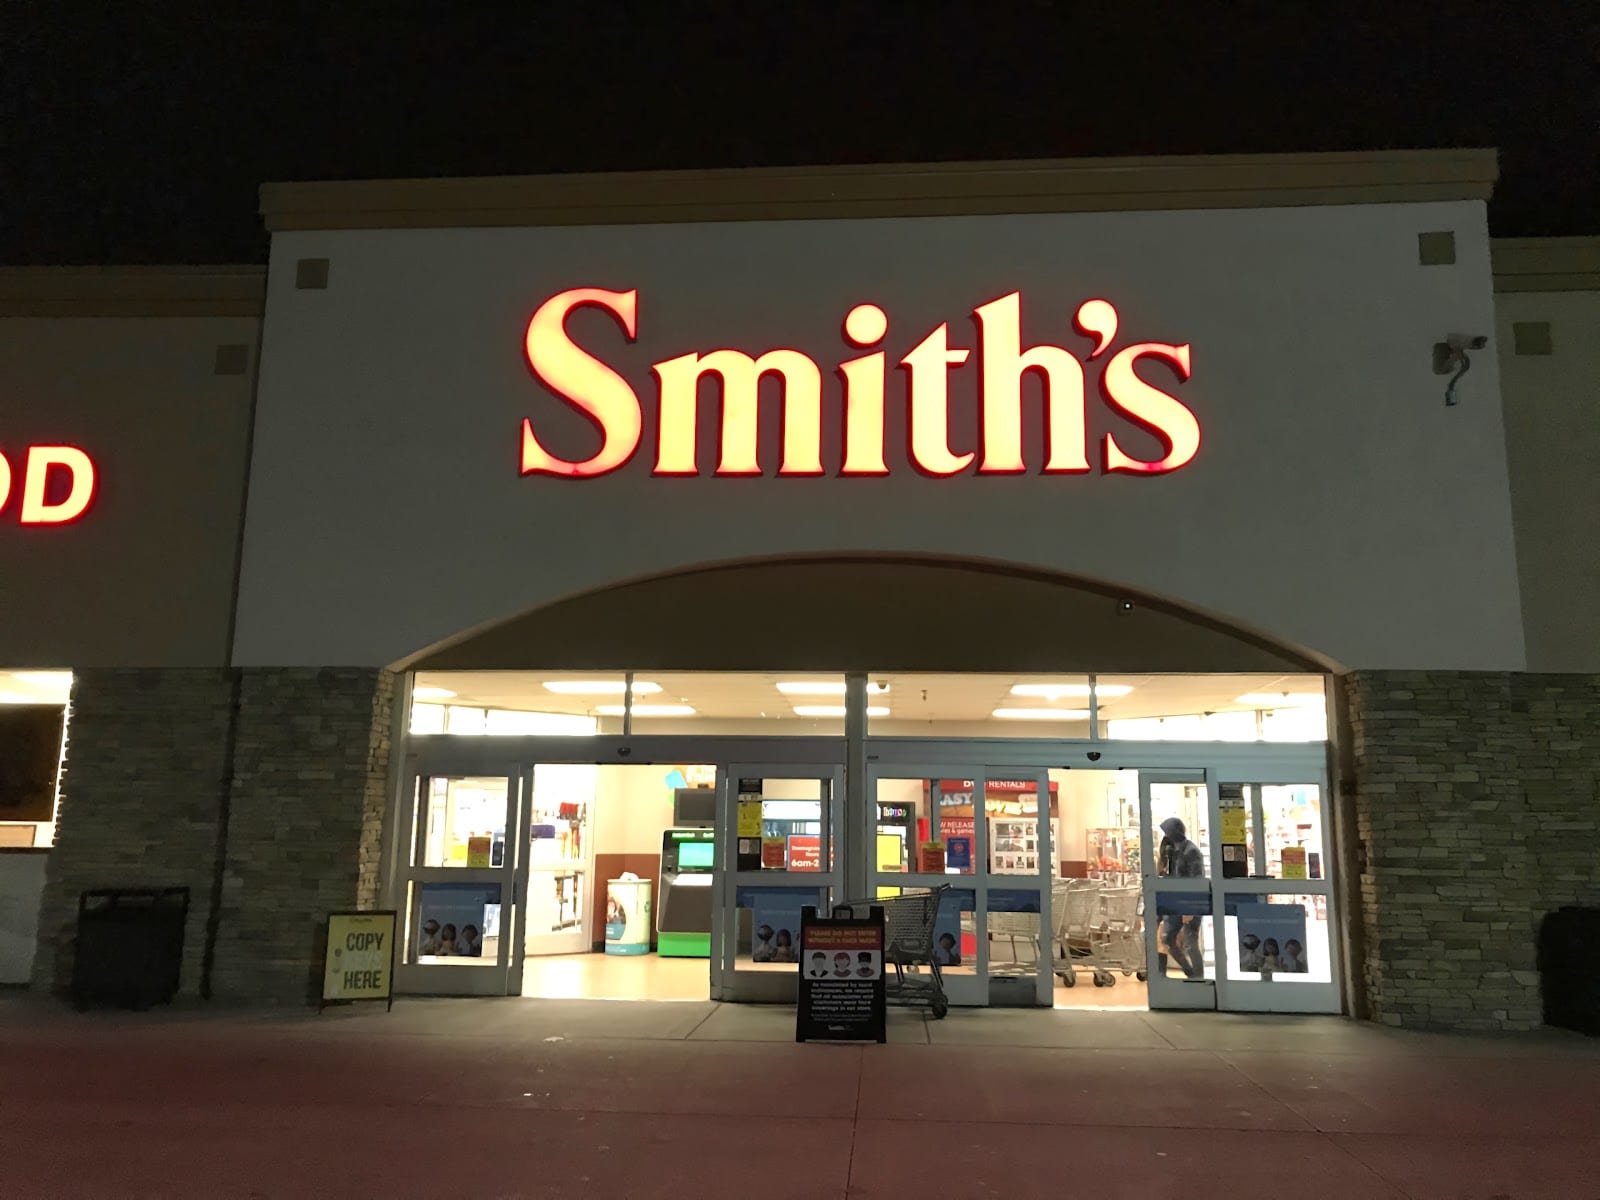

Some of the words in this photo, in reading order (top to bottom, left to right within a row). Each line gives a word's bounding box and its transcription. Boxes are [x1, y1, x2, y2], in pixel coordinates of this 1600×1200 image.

[519, 286, 1202, 477] Smith's
[988, 780, 1026, 789] RENTALS
[346, 932, 384, 951] COPY
[343, 970, 383, 989] HERE
